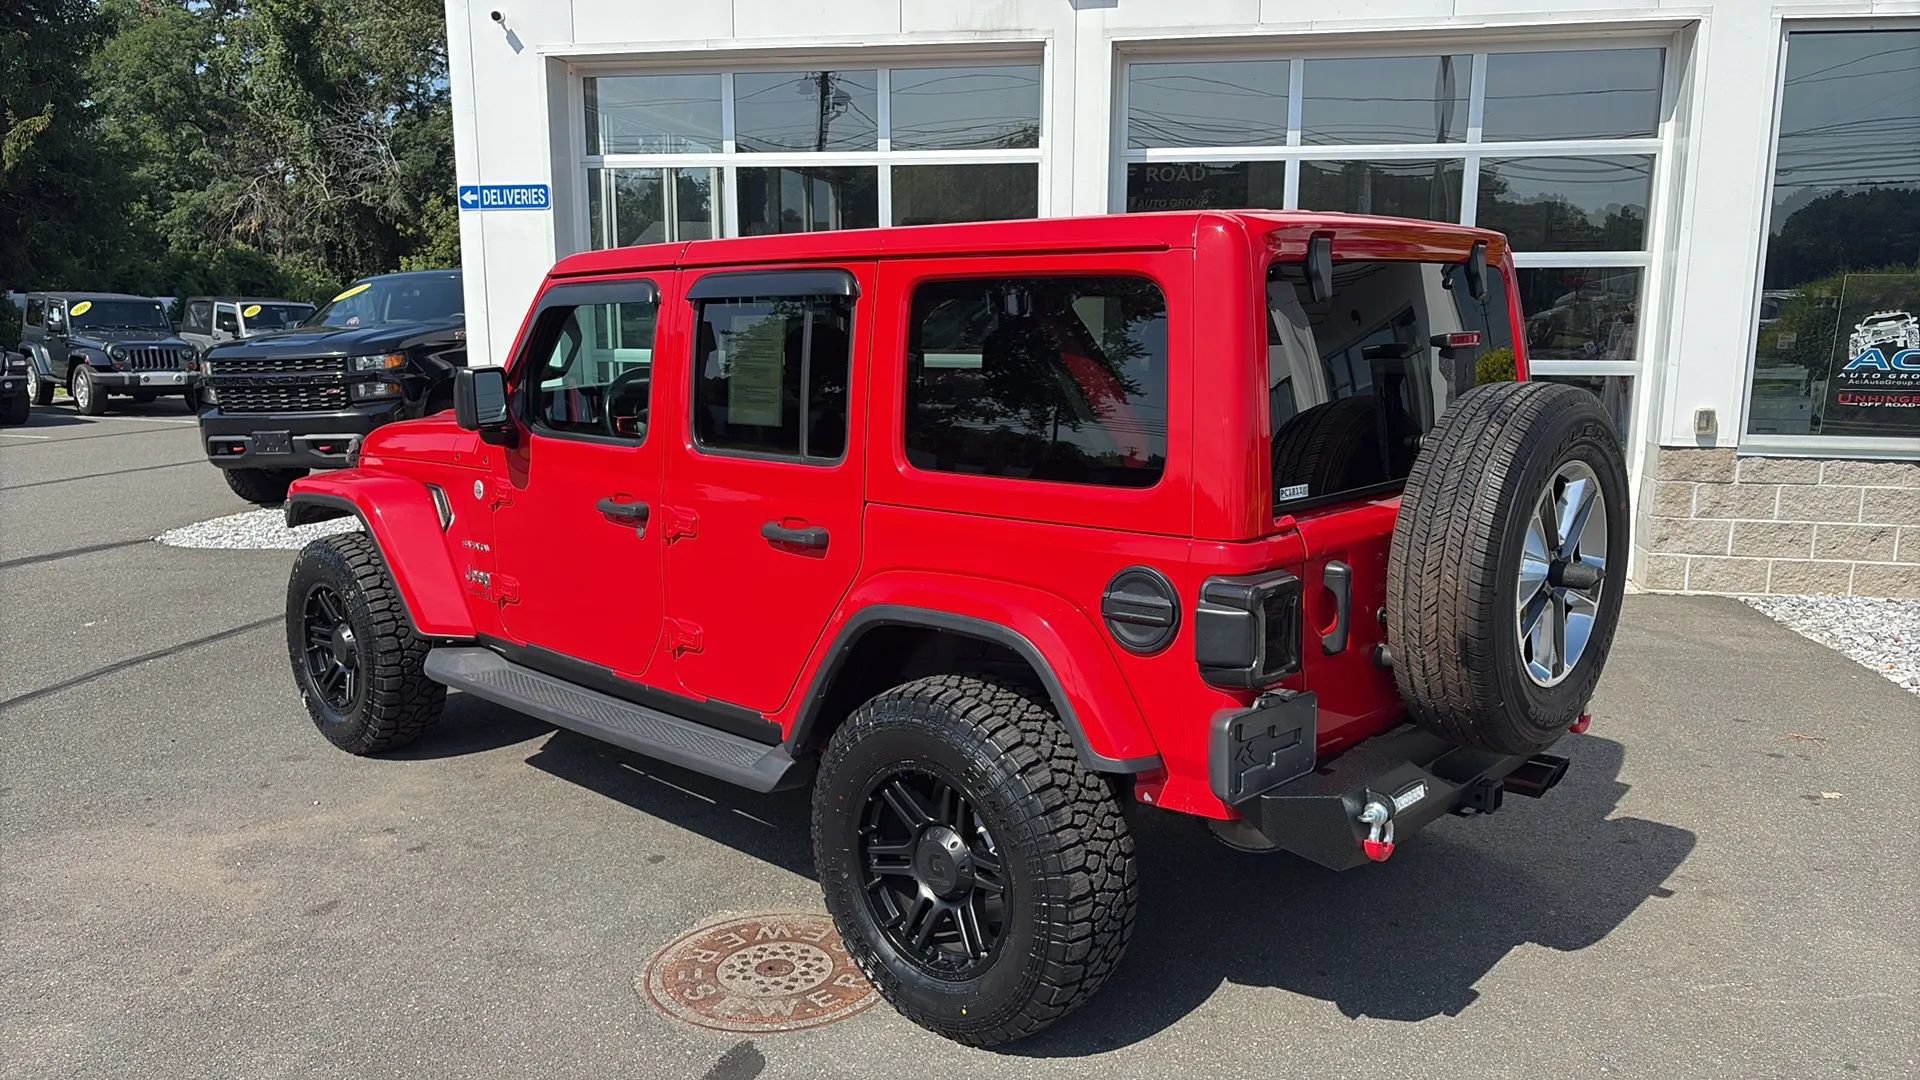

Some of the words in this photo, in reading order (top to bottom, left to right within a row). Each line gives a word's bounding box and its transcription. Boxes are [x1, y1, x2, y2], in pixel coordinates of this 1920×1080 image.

[1145, 166, 1207, 182] ROAD
[483, 188, 546, 205] DELIVERIES
[1138, 199, 1167, 209] AUTO
[1169, 198, 1209, 209] GROUP
[465, 563, 491, 589] Jeep
